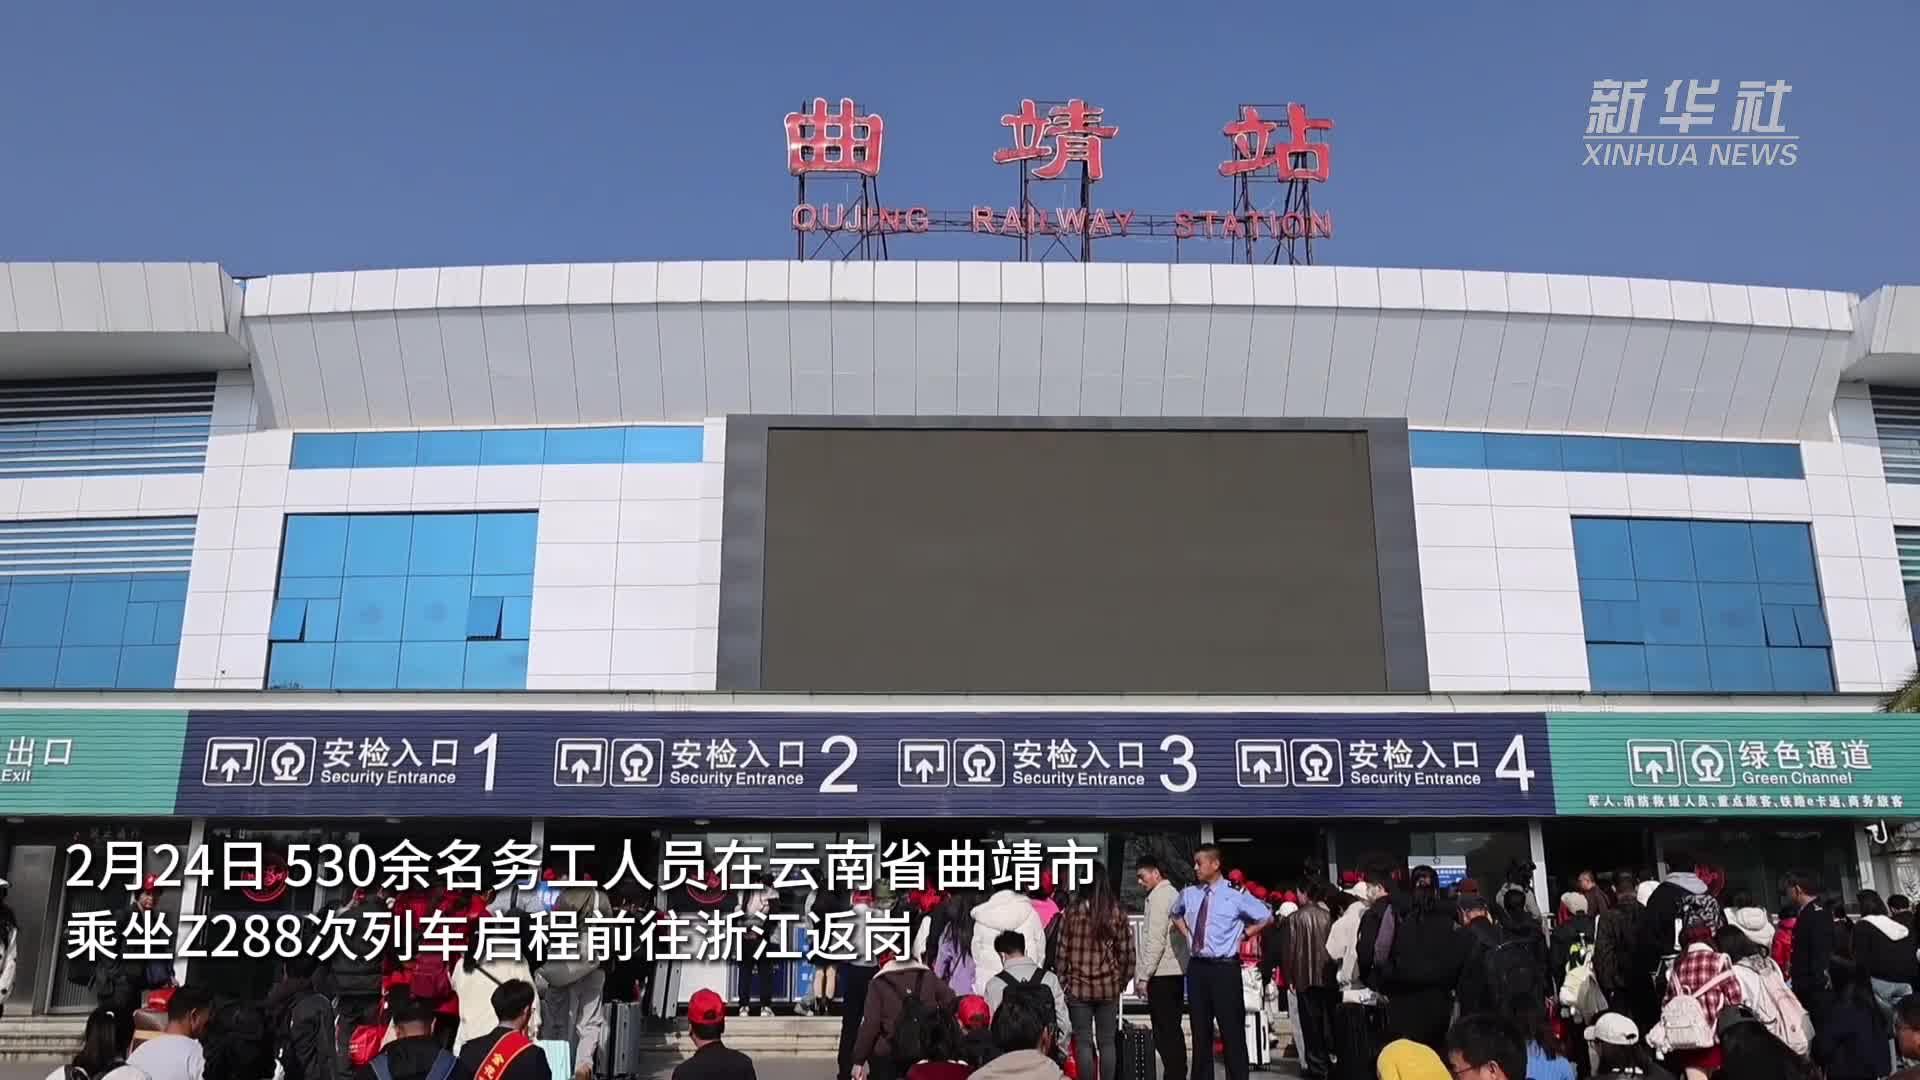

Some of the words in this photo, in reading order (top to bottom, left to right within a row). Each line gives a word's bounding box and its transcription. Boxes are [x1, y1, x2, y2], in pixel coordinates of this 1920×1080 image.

[784, 97, 1336, 182] 曲靖站
[791, 203, 929, 233] QUJING
[971, 206, 1136, 235] RAILWAY
[1174, 208, 1333, 240] STATION
[5, 736, 73, 767] 出口
[322, 736, 459, 769] 安检入口
[473, 732, 499, 792] 1
[671, 738, 805, 770] 安检入口
[818, 735, 859, 793] 2
[1012, 738, 1144, 770] 安检入口
[1159, 734, 1198, 793] 3
[1348, 739, 1480, 770] 安检入口
[1494, 734, 1535, 792] 4
[1738, 739, 1873, 770] 绿色通道
[0, 768, 32, 784] Exit
[320, 769, 384, 786] Security
[387, 770, 457, 785] Entrance
[670, 771, 734, 787] Security
[736, 772, 805, 786] Entrance
[1012, 771, 1076, 787] Security
[1078, 772, 1146, 786] Entrance
[1350, 771, 1413, 787] Security
[1415, 772, 1482, 786] Entrance
[1742, 771, 1788, 785] Green
[1791, 771, 1853, 785] Channel
